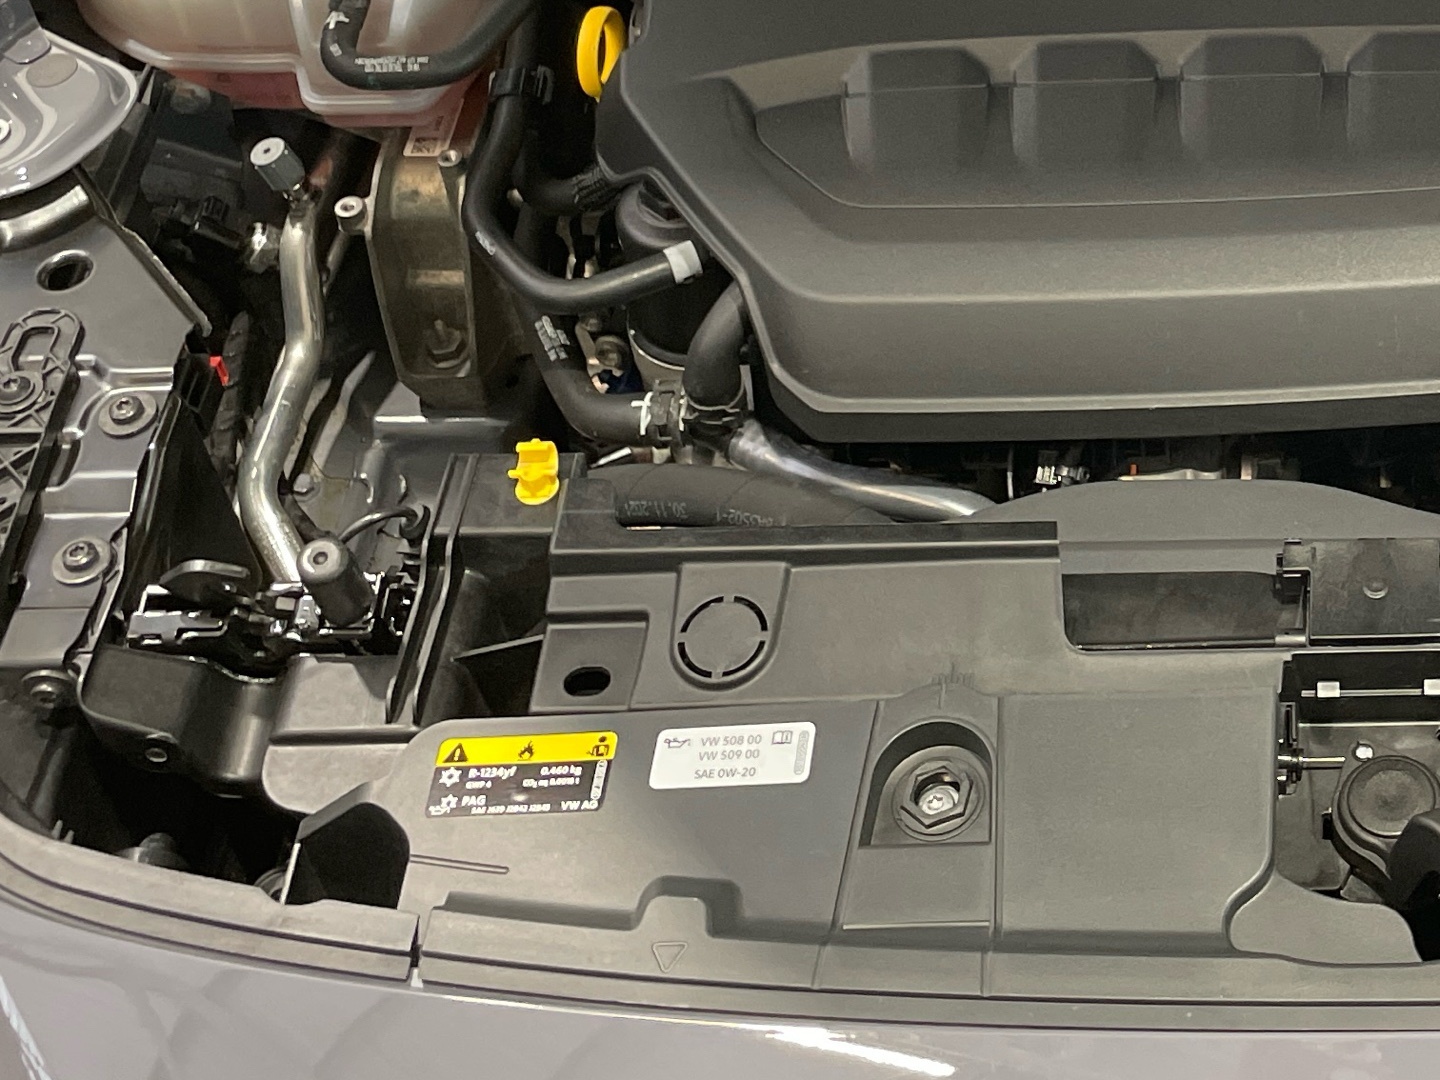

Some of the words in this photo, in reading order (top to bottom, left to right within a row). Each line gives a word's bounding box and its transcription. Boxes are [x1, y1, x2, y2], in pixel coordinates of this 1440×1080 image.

[701, 736, 721, 746] VW
[723, 735, 744, 745] 508
[747, 734, 762, 744] 00
[699, 750, 718, 761] VW
[720, 750, 741, 760] 509
[745, 749, 760, 759] 00
[468, 766, 517, 780] R-1234yf
[540, 767, 568, 776] 0.460
[570, 765, 582, 776] kg
[694, 769, 715, 779] SAE
[718, 767, 756, 778] 0W-20
[461, 795, 487, 807] PAG
[561, 800, 581, 811] VW
[581, 799, 599, 810] AG
